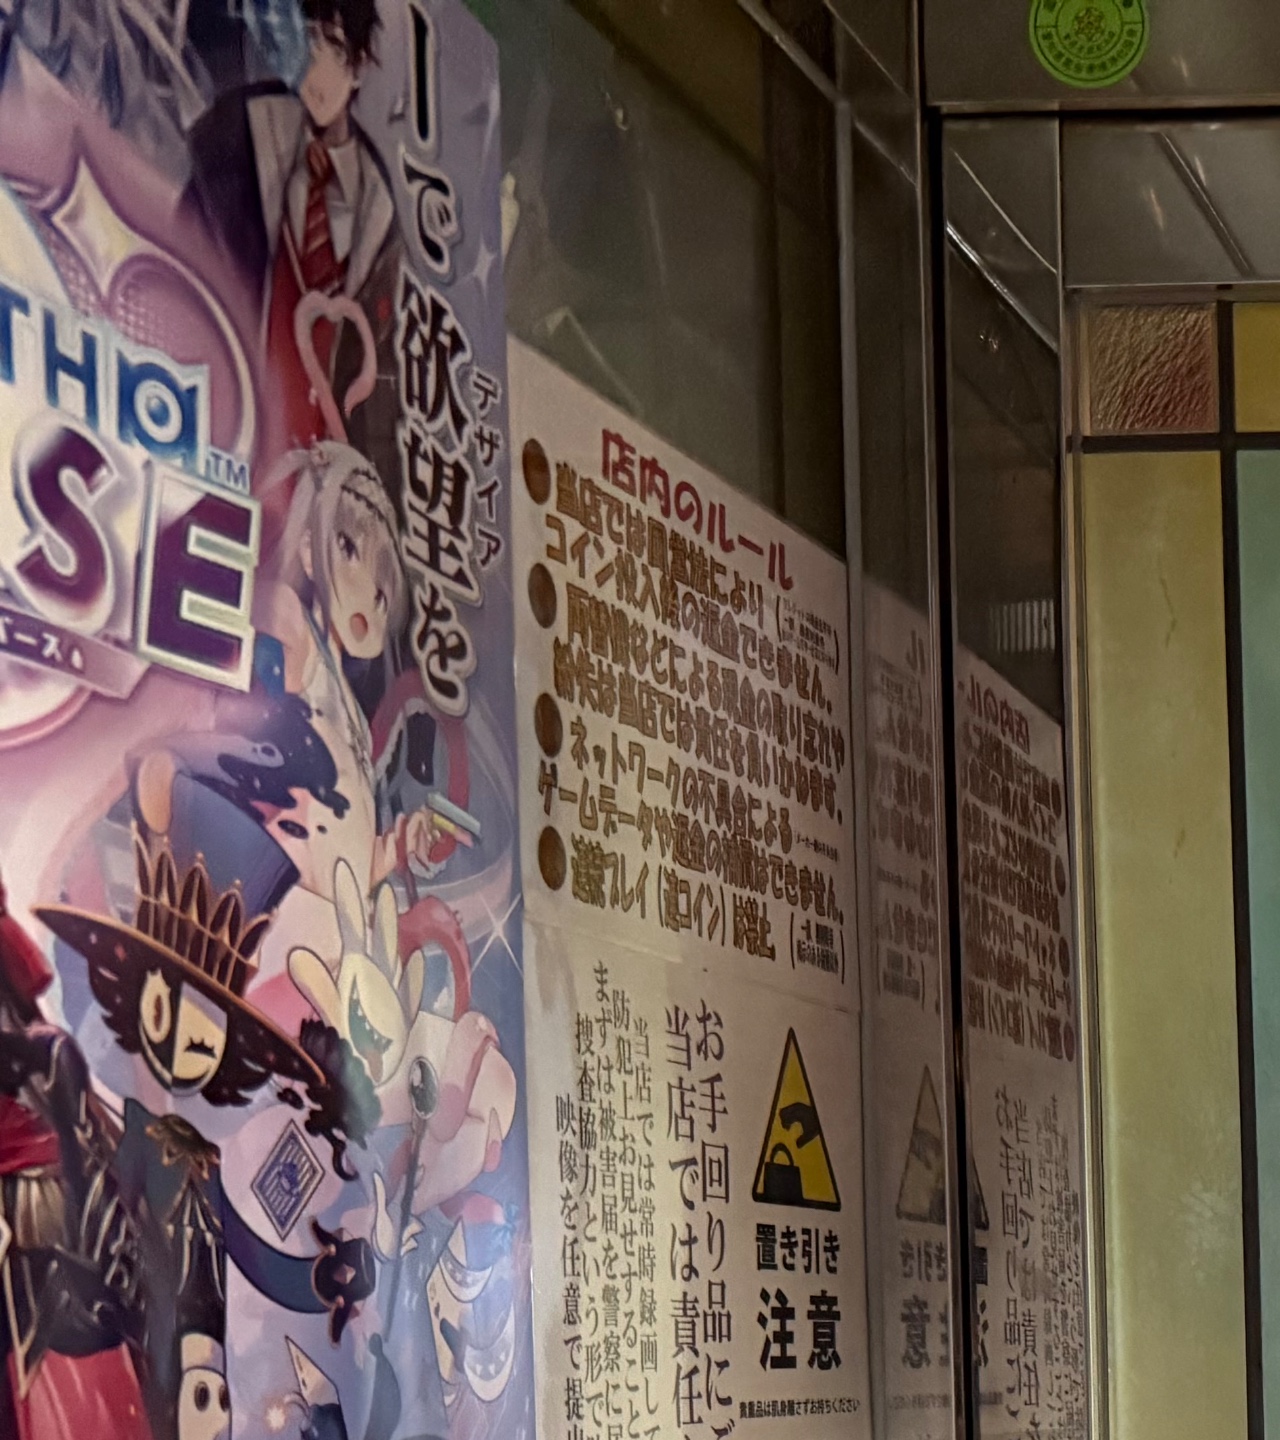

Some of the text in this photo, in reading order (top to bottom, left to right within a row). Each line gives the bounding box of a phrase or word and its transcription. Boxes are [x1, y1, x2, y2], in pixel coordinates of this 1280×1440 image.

[471, 372, 502, 568] デザイア
[602, 429, 793, 590] 店内のルール
[556, 461, 763, 629] 当店では風営法により
[570, 715, 792, 853] ネットワークの不具合による
[755, 1224, 840, 1276] 置き引き
[757, 1288, 841, 1371] 注意
